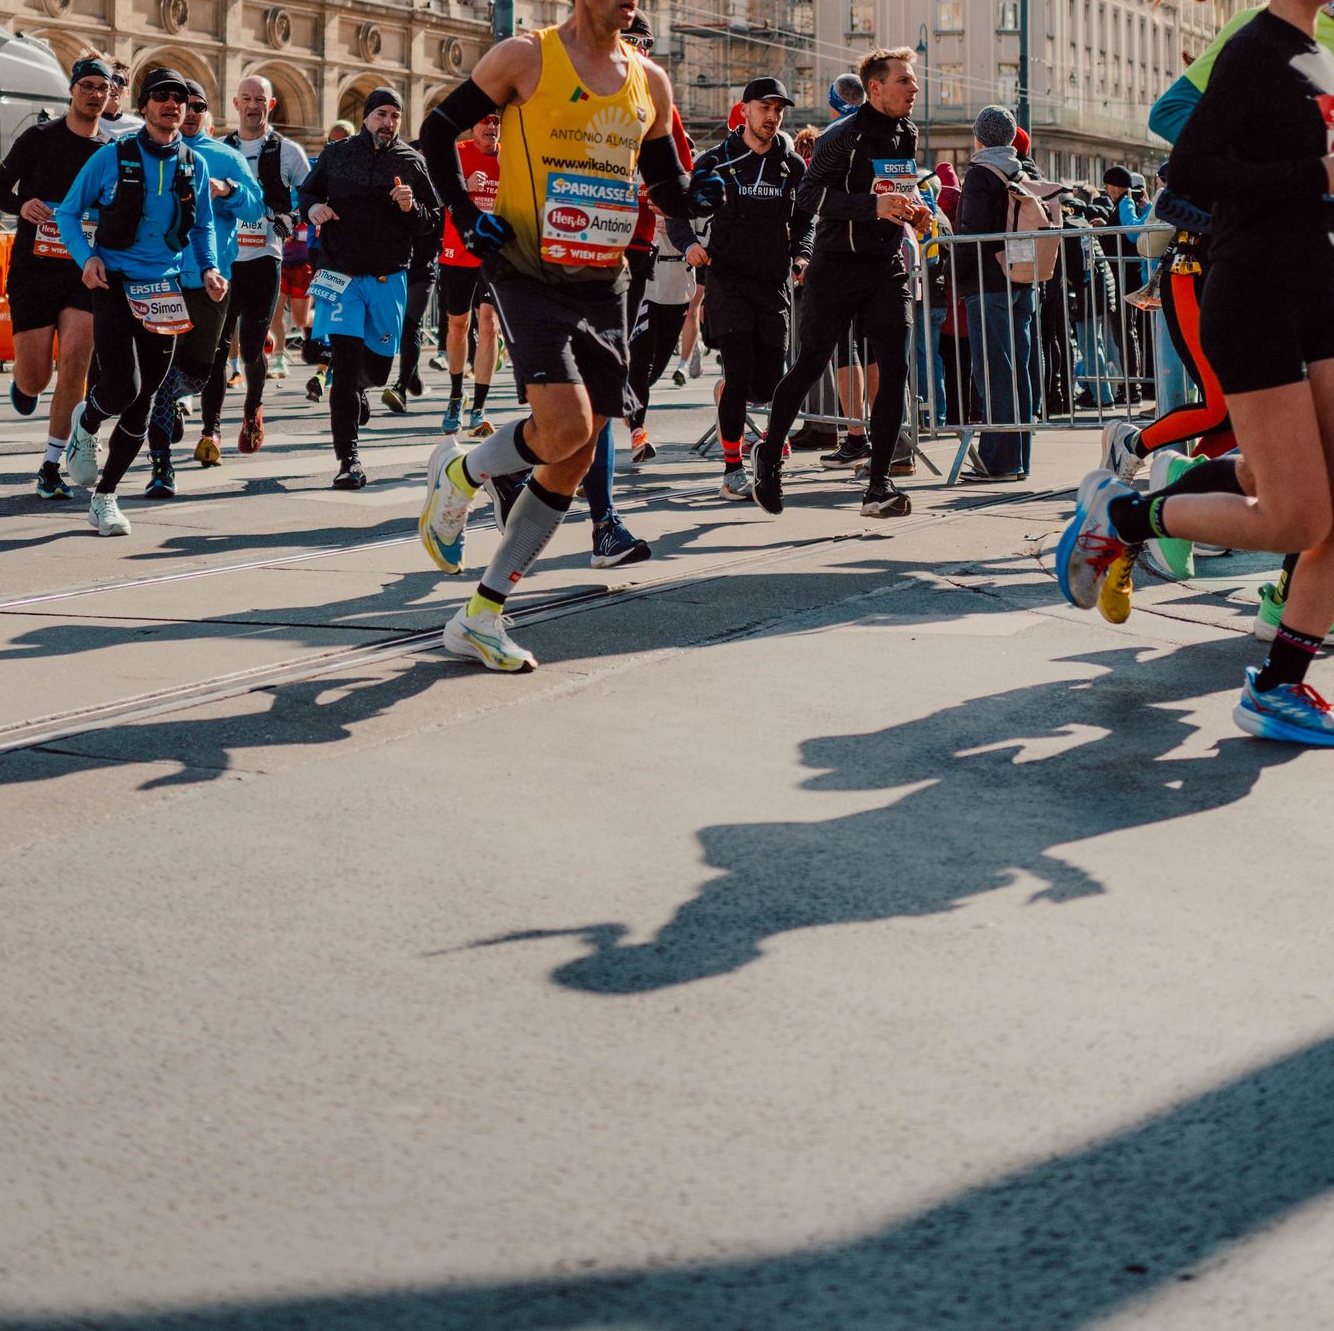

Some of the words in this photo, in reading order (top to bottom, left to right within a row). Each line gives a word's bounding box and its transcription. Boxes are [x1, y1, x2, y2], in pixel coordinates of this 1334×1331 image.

[550, 127, 603, 144] ANTÓNIO
[884, 163, 905, 173] ERSTE
[552, 180, 625, 202] SPARKASSE
[552, 212, 587, 229] Hervis
[590, 215, 632, 234] António
[570, 247, 596, 262] WIEN
[321, 270, 346, 287] Thomas
[130, 282, 161, 295] ERSTE
[150, 302, 183, 315] Simon
[330, 302, 343, 322] 2
